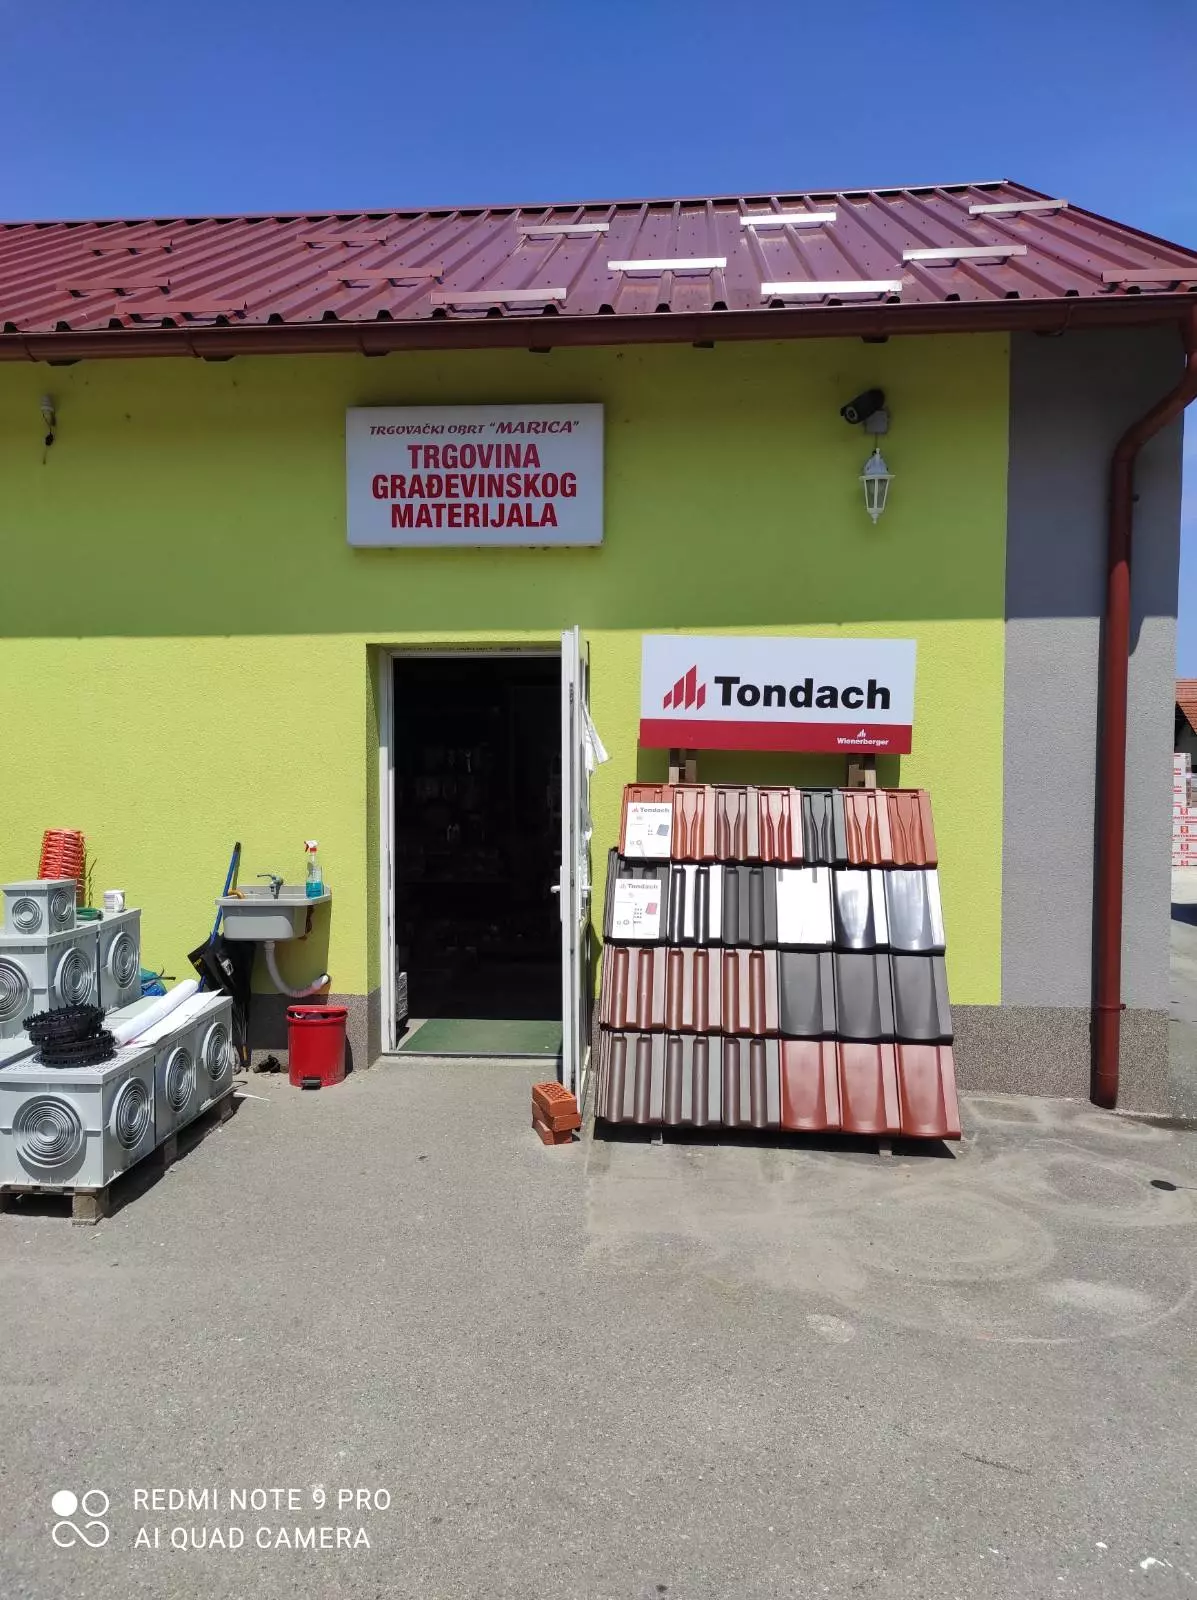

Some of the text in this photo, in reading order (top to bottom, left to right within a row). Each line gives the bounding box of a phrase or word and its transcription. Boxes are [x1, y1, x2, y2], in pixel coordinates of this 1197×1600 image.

[370, 423, 444, 435] TRGOVAČKI
[447, 424, 485, 436] OBRT
[407, 443, 541, 469] TRGOVINA
[372, 472, 577, 499] GRAĐEVINSKOG
[391, 502, 558, 528] MATERIJALA
[714, 676, 891, 710] Tondach
[837, 737, 889, 747] Wienerberger
[640, 806, 670, 814] Tondach
